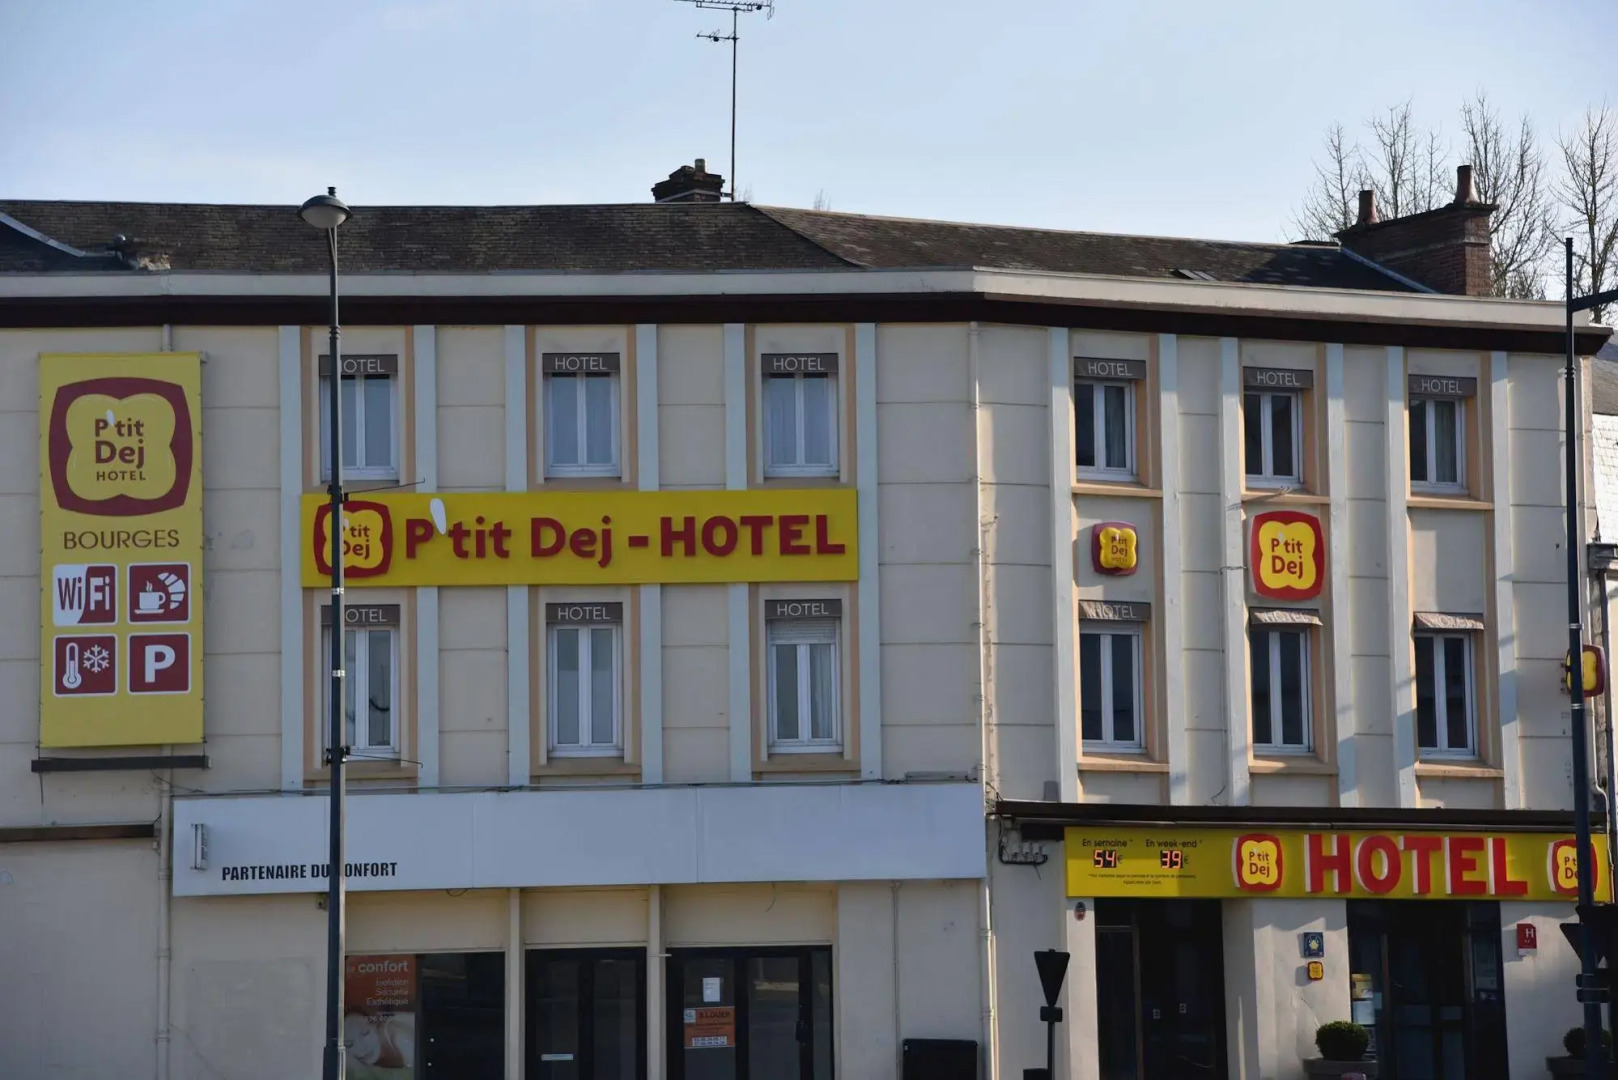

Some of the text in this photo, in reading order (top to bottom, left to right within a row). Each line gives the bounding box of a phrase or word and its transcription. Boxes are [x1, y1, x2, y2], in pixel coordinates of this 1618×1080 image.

[340, 359, 385, 373] OTEL
[555, 356, 608, 371] HOTEL
[773, 357, 825, 371] HOTEL
[1088, 362, 1132, 376] HOTEL
[1257, 371, 1300, 386] HOTEL
[1421, 379, 1462, 394] HOTEL
[95, 438, 144, 469] Dej
[96, 471, 146, 481] HOTEL
[64, 529, 180, 550] BOURGES
[531, 516, 612, 568] Dej
[660, 515, 846, 557] HOTEL
[1271, 555, 1304, 579] Dej
[57, 576, 111, 611] WiFi
[345, 608, 387, 622] OTEL
[558, 606, 611, 620] HOTEL
[776, 603, 829, 616] HOTEL
[145, 644, 176, 683] P
[1082, 838, 1092, 847] En
[1145, 839, 1155, 848] En
[222, 862, 397, 881] PARTENAIRE DU ONFORT
[1250, 861, 1270, 877] Dej
[1303, 833, 1528, 895] HOTEL
[358, 960, 409, 973] confort
